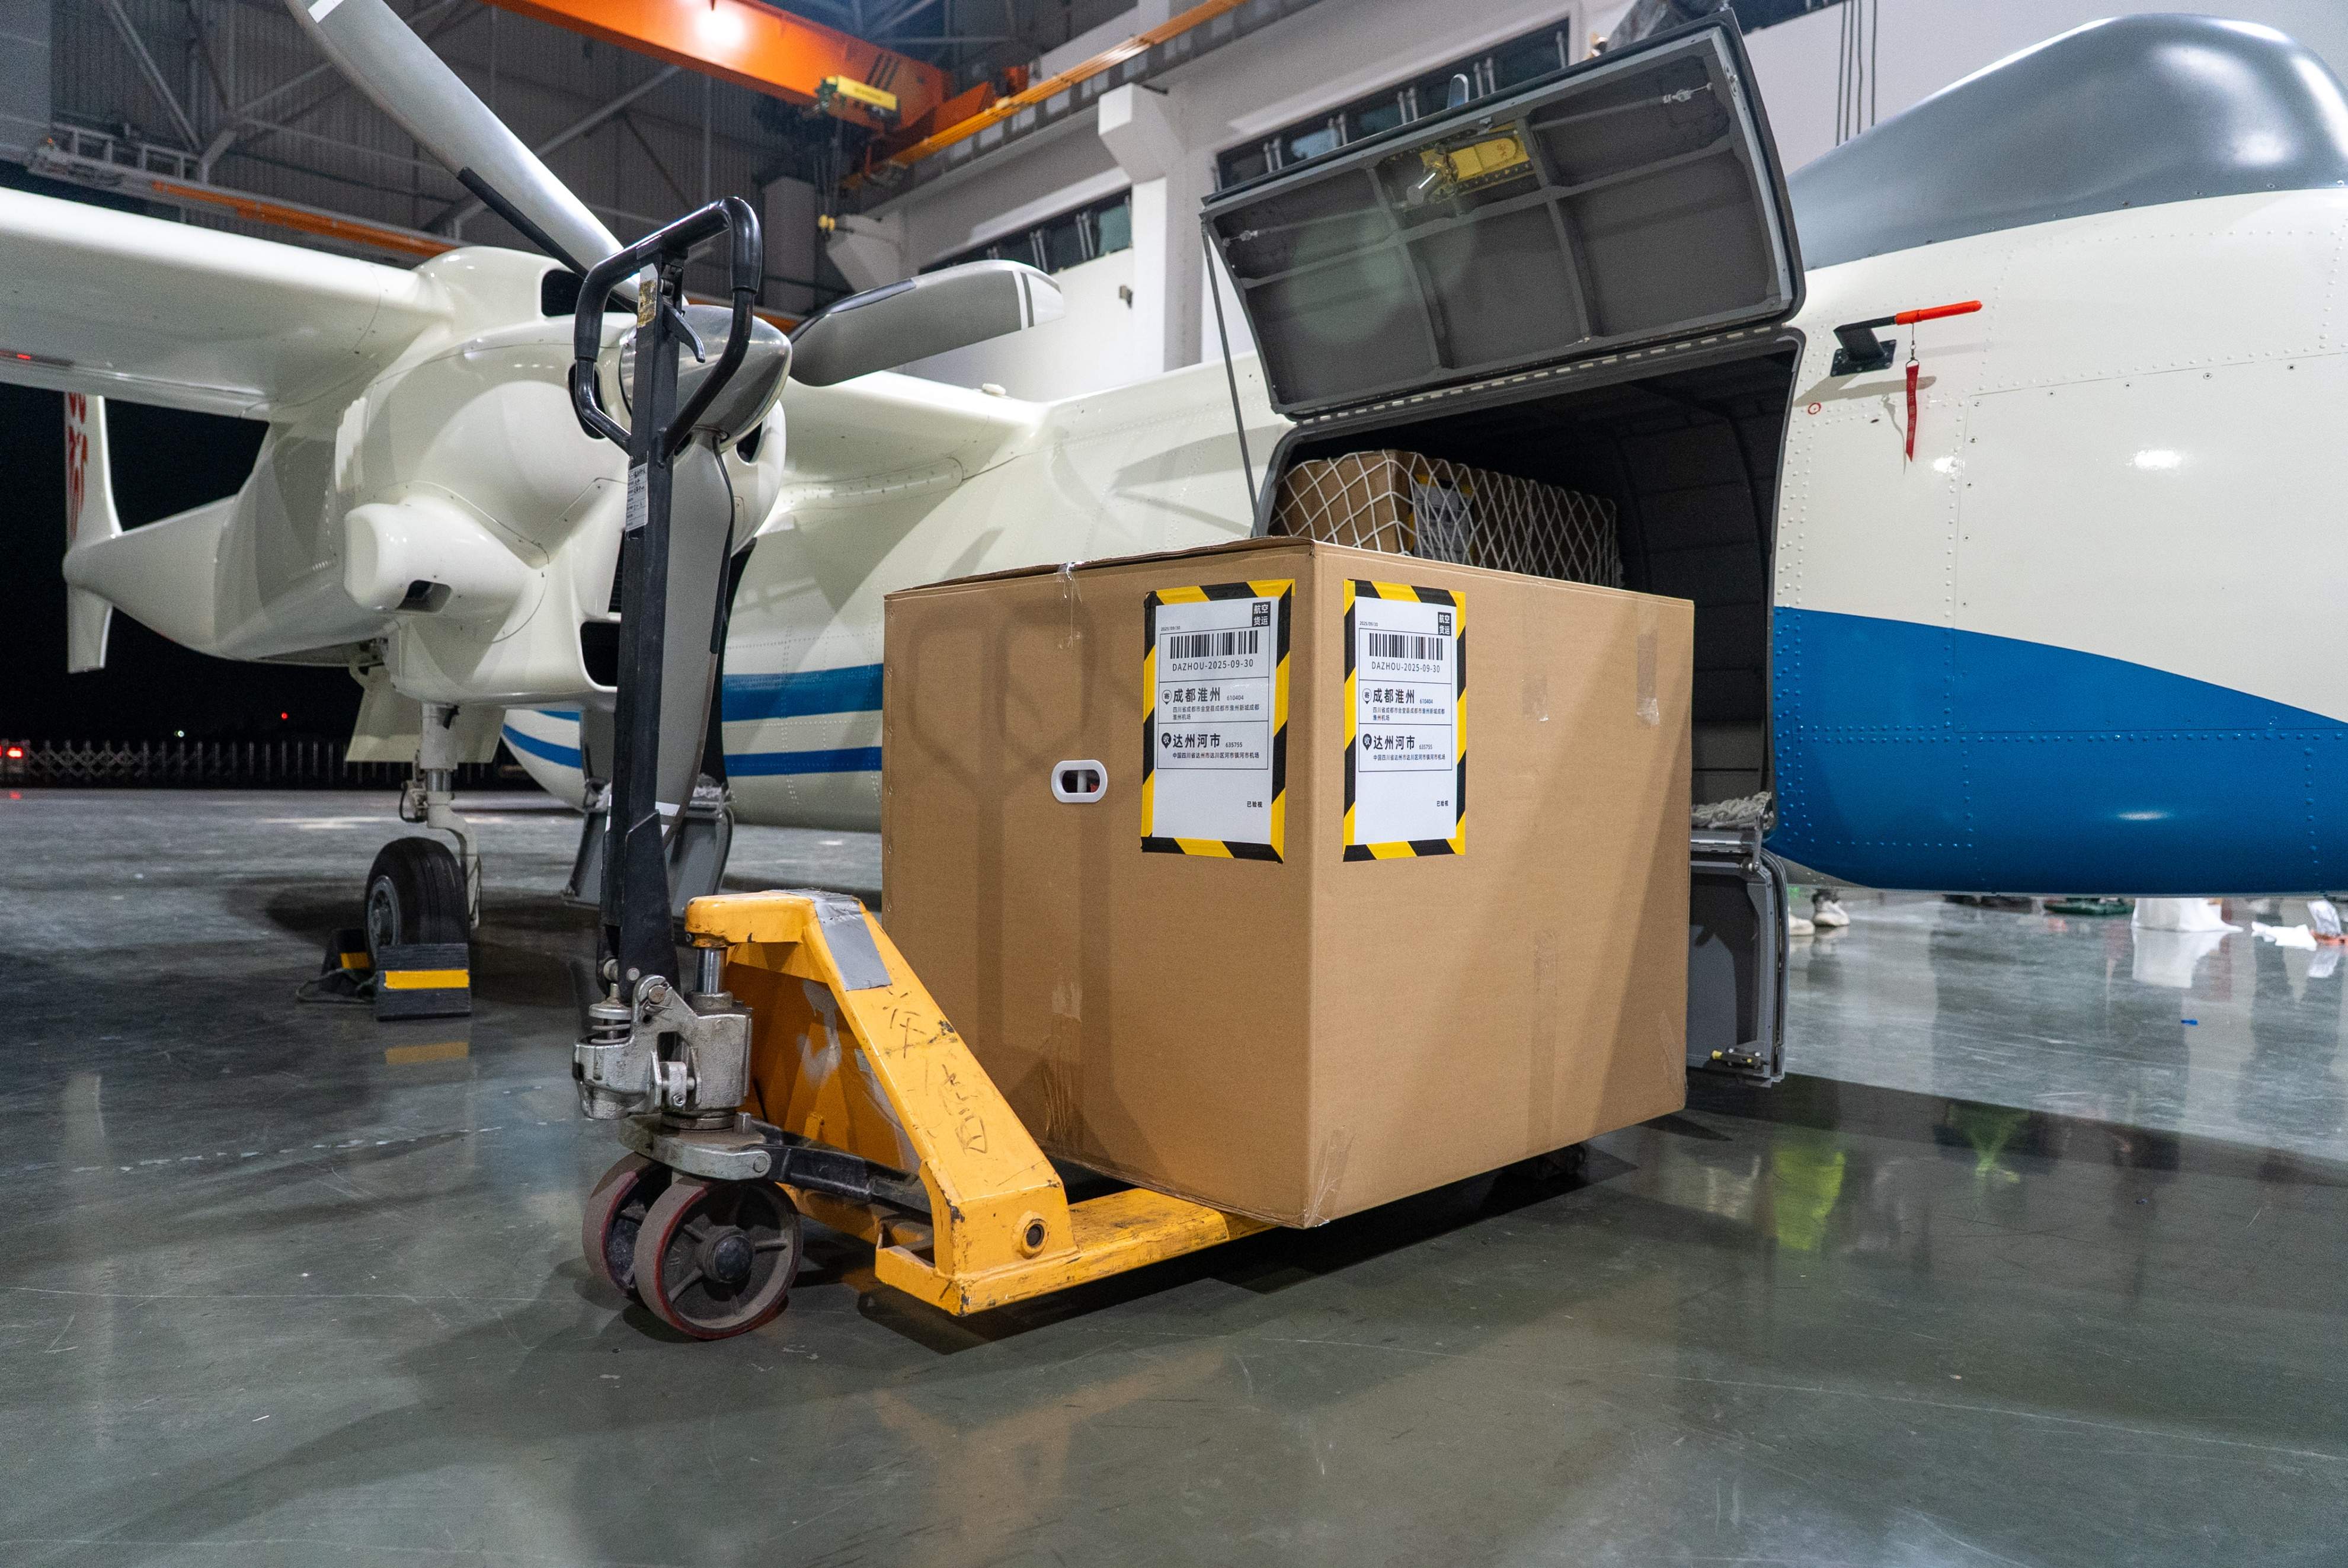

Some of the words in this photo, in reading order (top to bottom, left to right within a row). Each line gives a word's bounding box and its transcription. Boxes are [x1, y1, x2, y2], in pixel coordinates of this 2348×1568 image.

[1253, 604, 1269, 614] 航空
[1253, 616, 1268, 626] 货运
[1439, 615, 1450, 624] 航空
[1439, 626, 1450, 635] 货运
[1172, 659, 1253, 671] DAZHOU-2025-09-30
[1372, 661, 1440, 673] DAZHOU-2025-09-30
[1173, 687, 1221, 703] 成都淮州
[1373, 688, 1414, 703] 成都淮州
[1173, 734, 1221, 748] 达州河市
[1373, 735, 1415, 750] 达州河市
